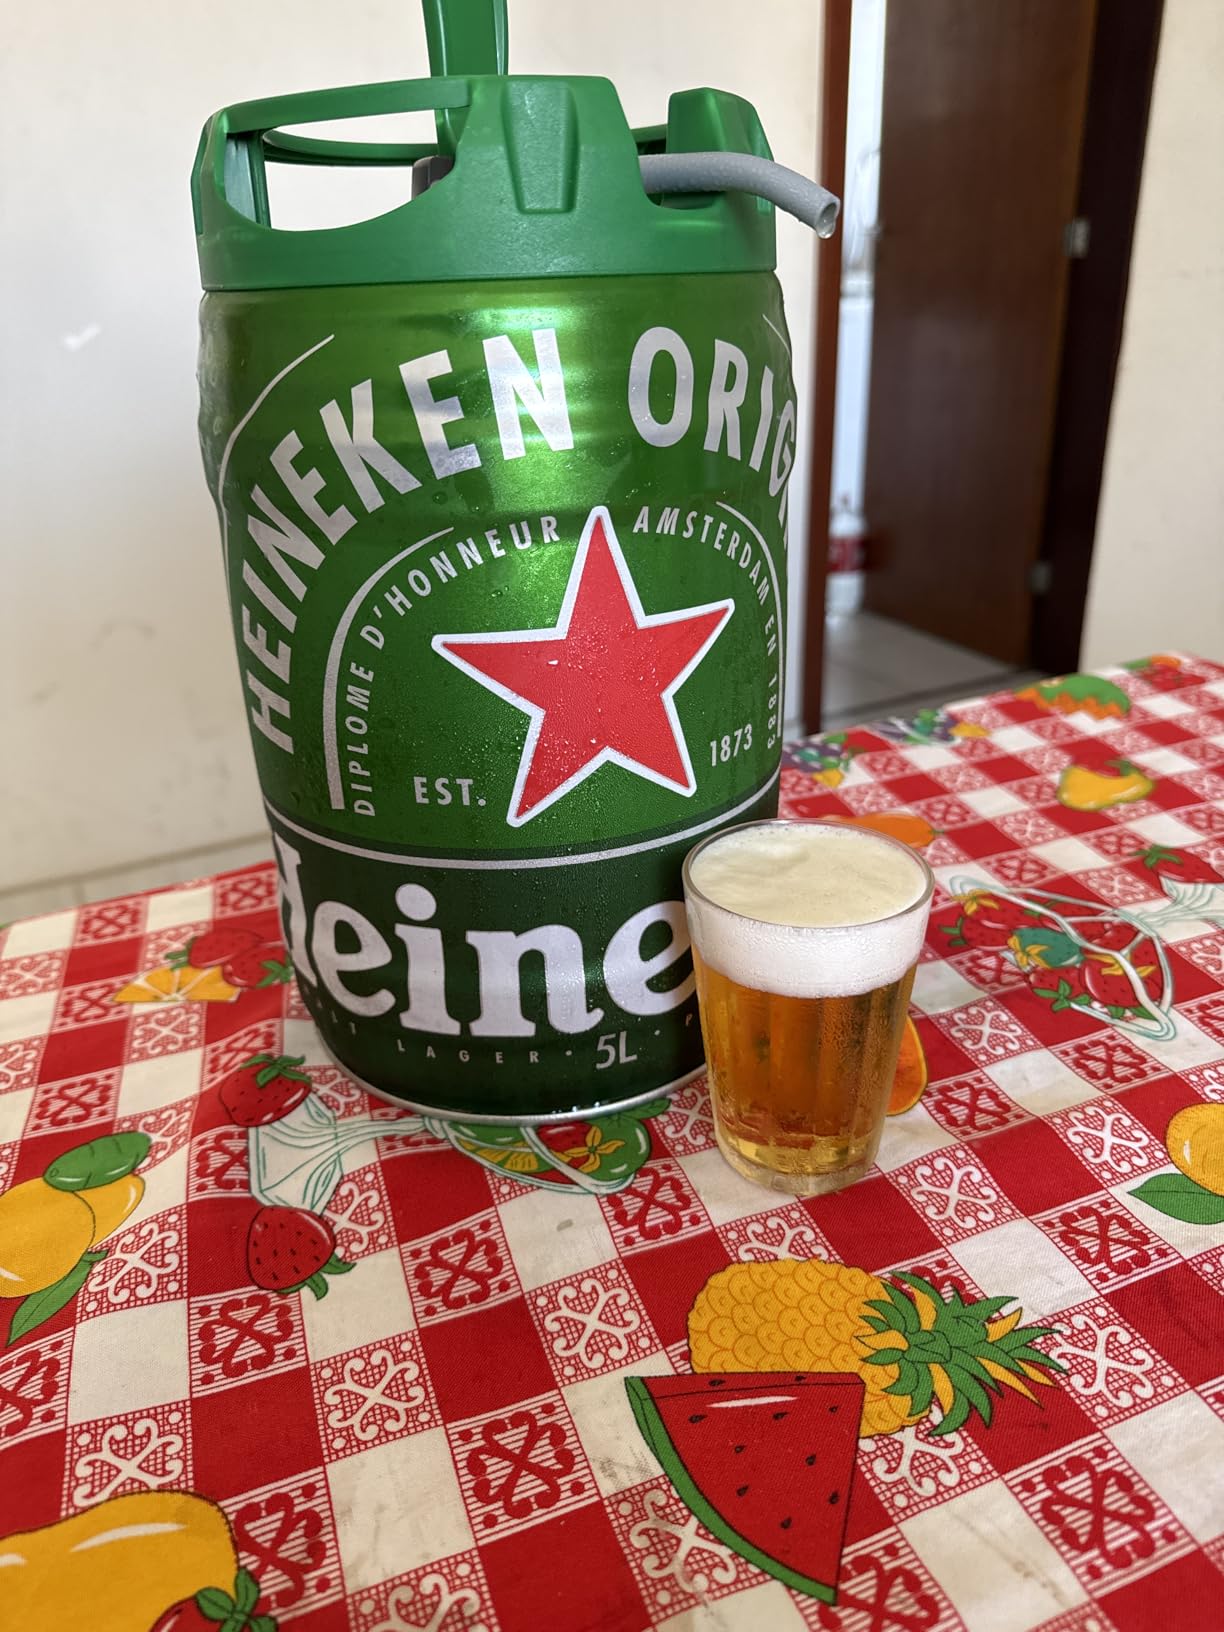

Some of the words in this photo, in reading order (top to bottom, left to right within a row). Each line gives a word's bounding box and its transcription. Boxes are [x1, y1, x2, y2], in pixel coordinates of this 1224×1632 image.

[242, 327, 575, 755] HEINEKEN
[627, 325, 798, 551] ORIG
[359, 515, 560, 650] D'HONNEUR
[632, 505, 770, 606] AMSTERDAM
[764, 614, 777, 656] EN
[344, 661, 375, 817] DIPLOME
[766, 673, 778, 749] 1883
[413, 776, 487, 807] EST.
[709, 723, 753, 767] 1873
[397, 1039, 541, 1064] LAGER
[595, 1030, 638, 1070] 5L
